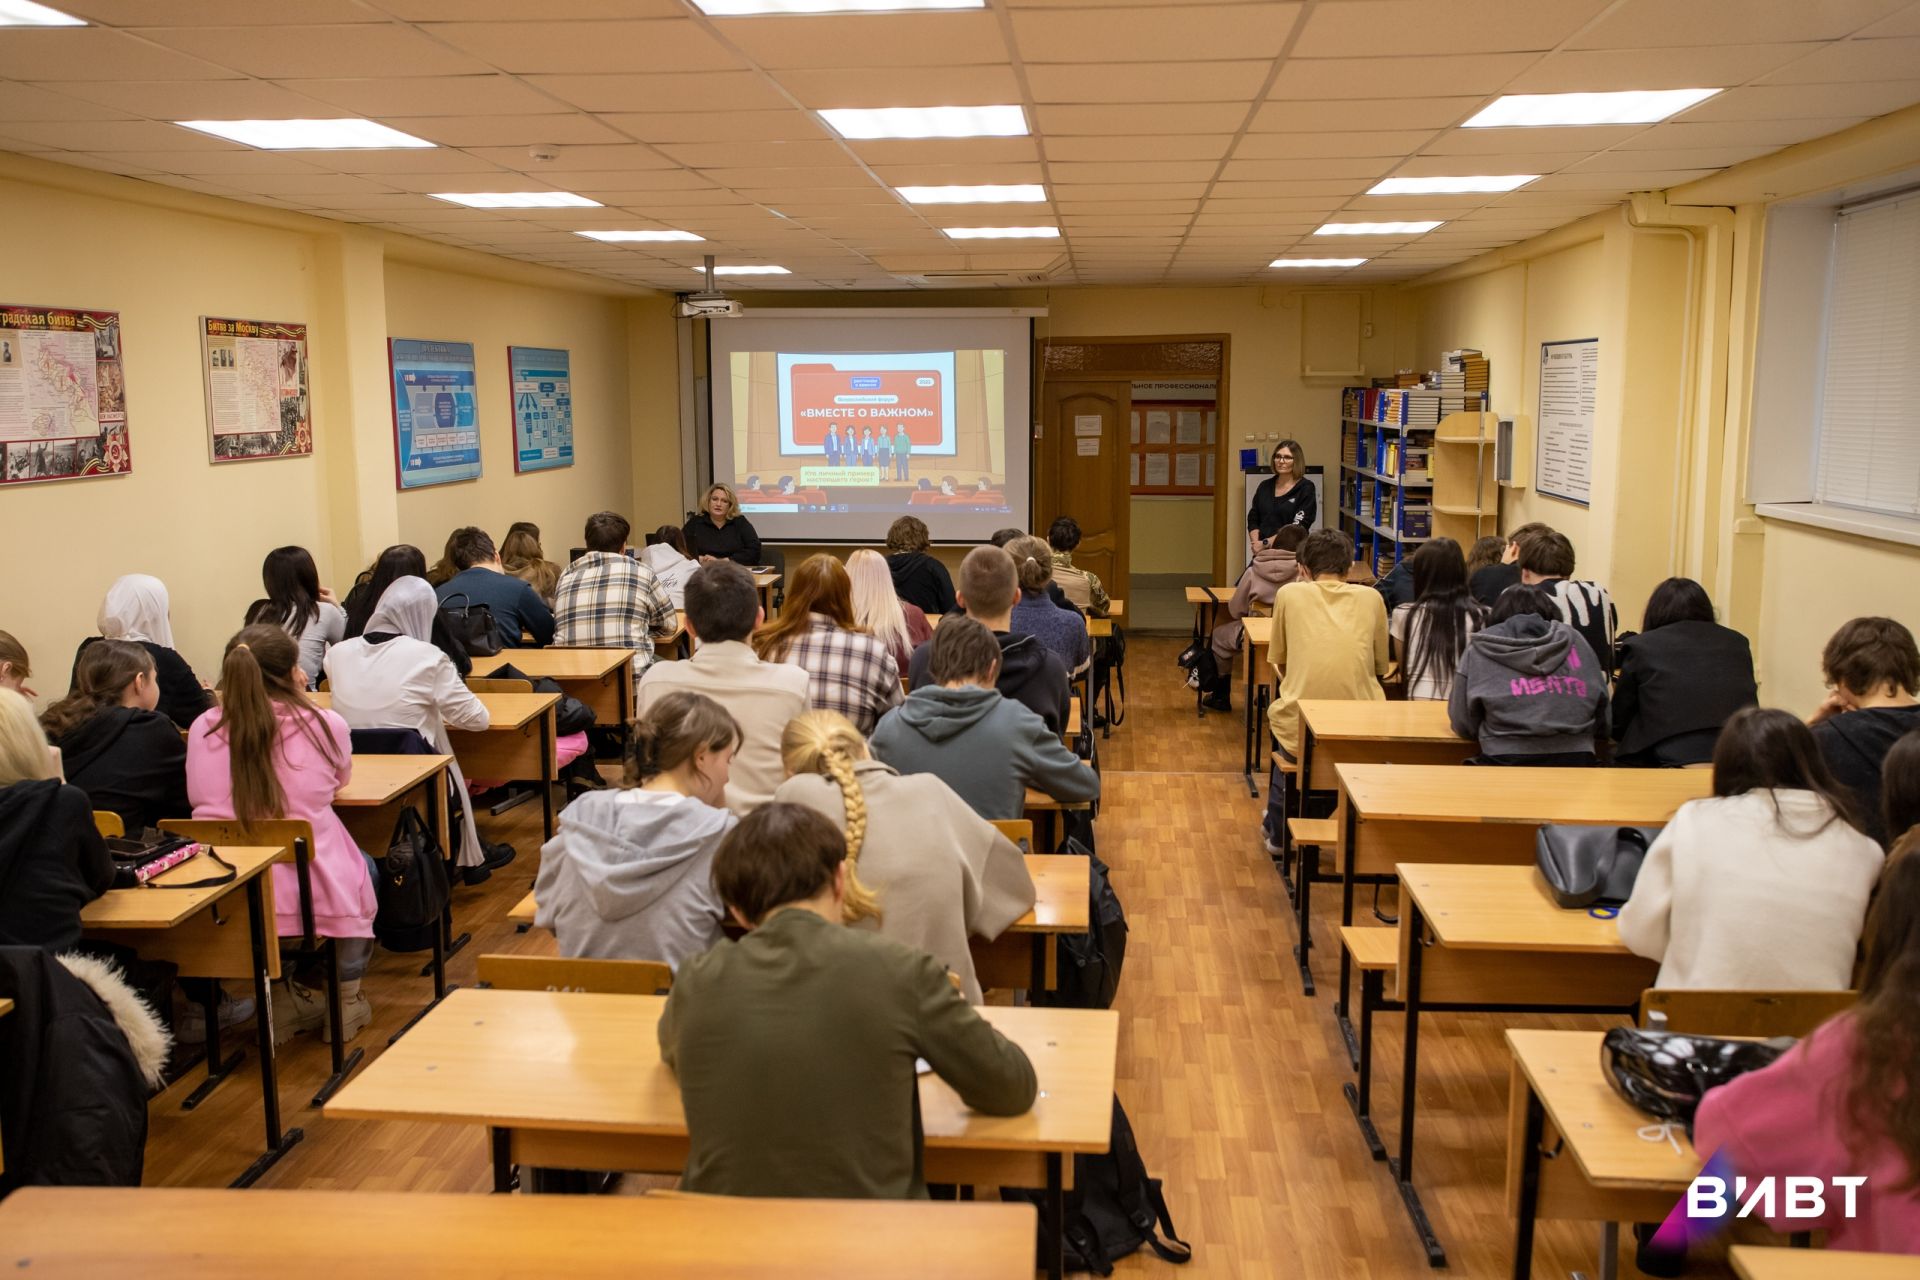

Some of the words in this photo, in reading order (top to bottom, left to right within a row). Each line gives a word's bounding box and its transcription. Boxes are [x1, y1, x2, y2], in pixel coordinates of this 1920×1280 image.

[47, 311, 76, 327] битва
[207, 319, 227, 331] Битва
[228, 323, 235, 333] за
[235, 321, 259, 337] Москву
[800, 408, 855, 418] «ВМЕСТЕ
[857, 408, 867, 418] О
[870, 408, 934, 418] ВАЖНОМ»
